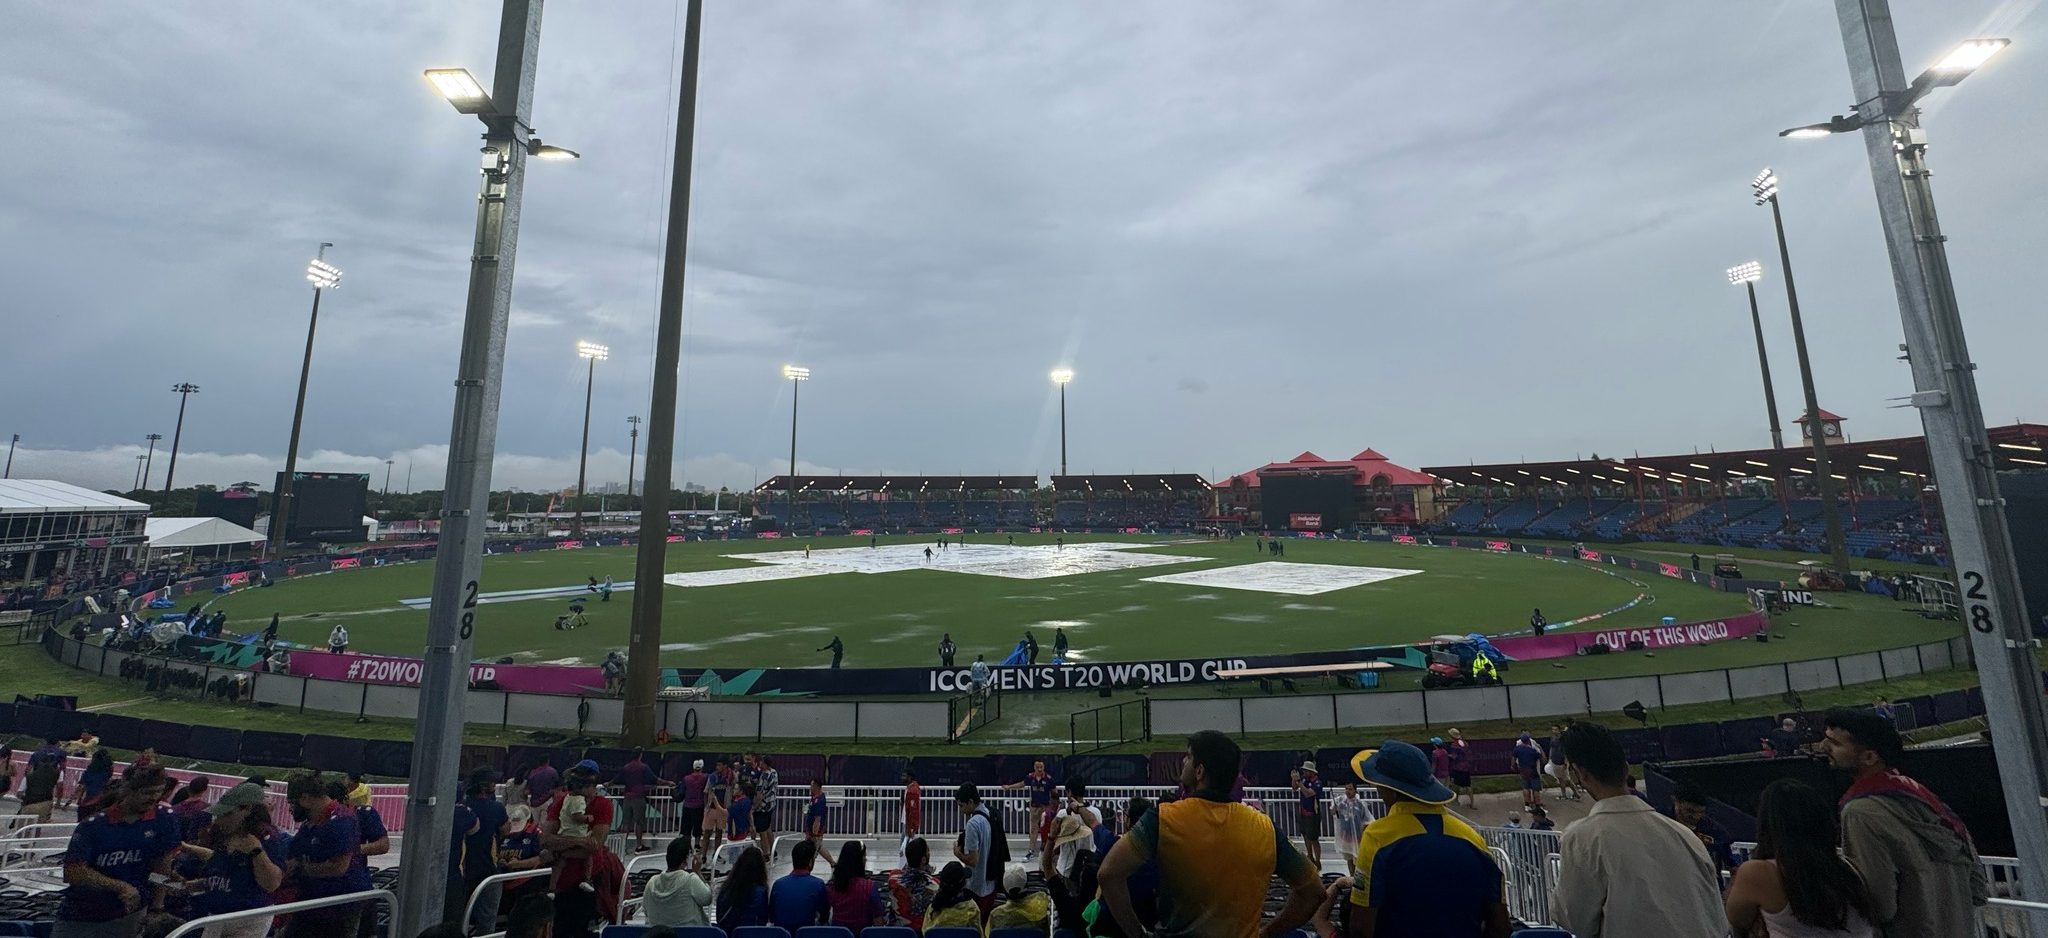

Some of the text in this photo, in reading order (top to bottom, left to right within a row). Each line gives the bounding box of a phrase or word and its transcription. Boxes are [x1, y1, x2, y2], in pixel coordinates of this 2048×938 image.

[1595, 621, 1729, 649] OUT OF THIS WORLD
[929, 658, 1248, 692] ICC MEN'S T20 WORLD CUP
[96, 848, 143, 867] NEPAL
